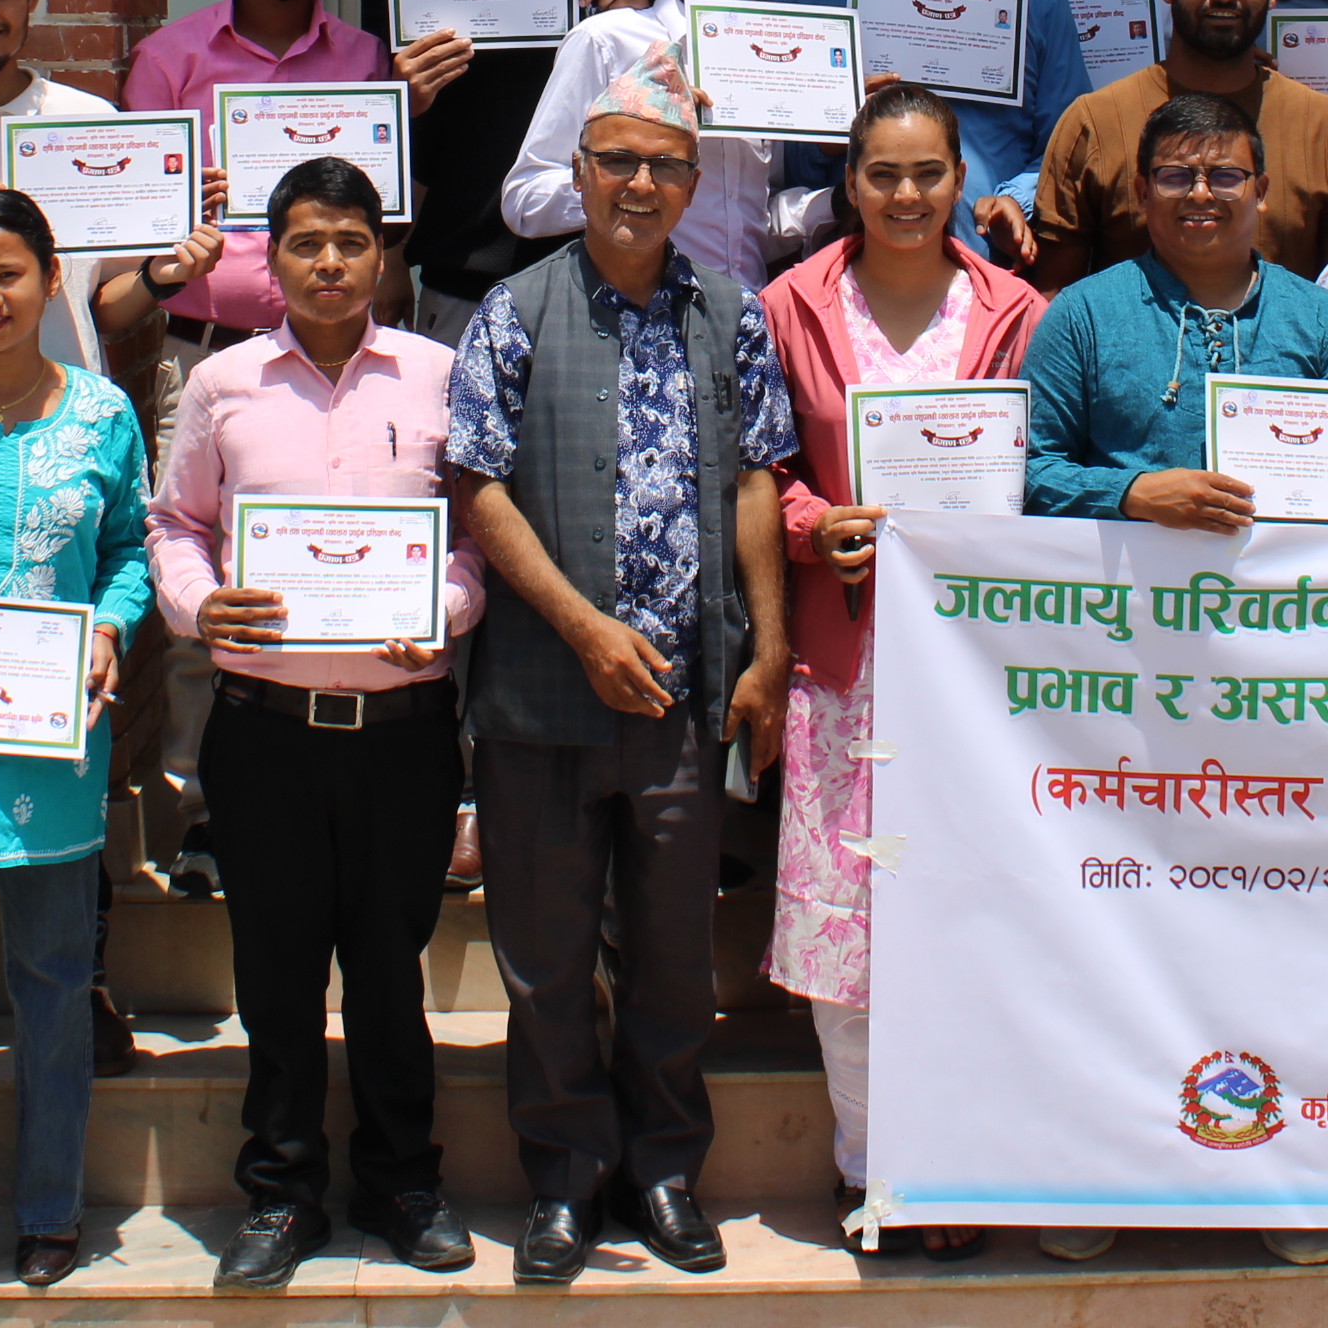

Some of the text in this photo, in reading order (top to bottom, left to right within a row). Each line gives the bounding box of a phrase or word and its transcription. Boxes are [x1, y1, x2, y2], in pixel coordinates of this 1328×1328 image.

[934, 573, 1133, 642] जलवायु
[1005, 666, 1138, 715] प्रभाव
[1156, 674, 1191, 720] र
[1032, 756, 1324, 820] (कर्मचारीस्तर
